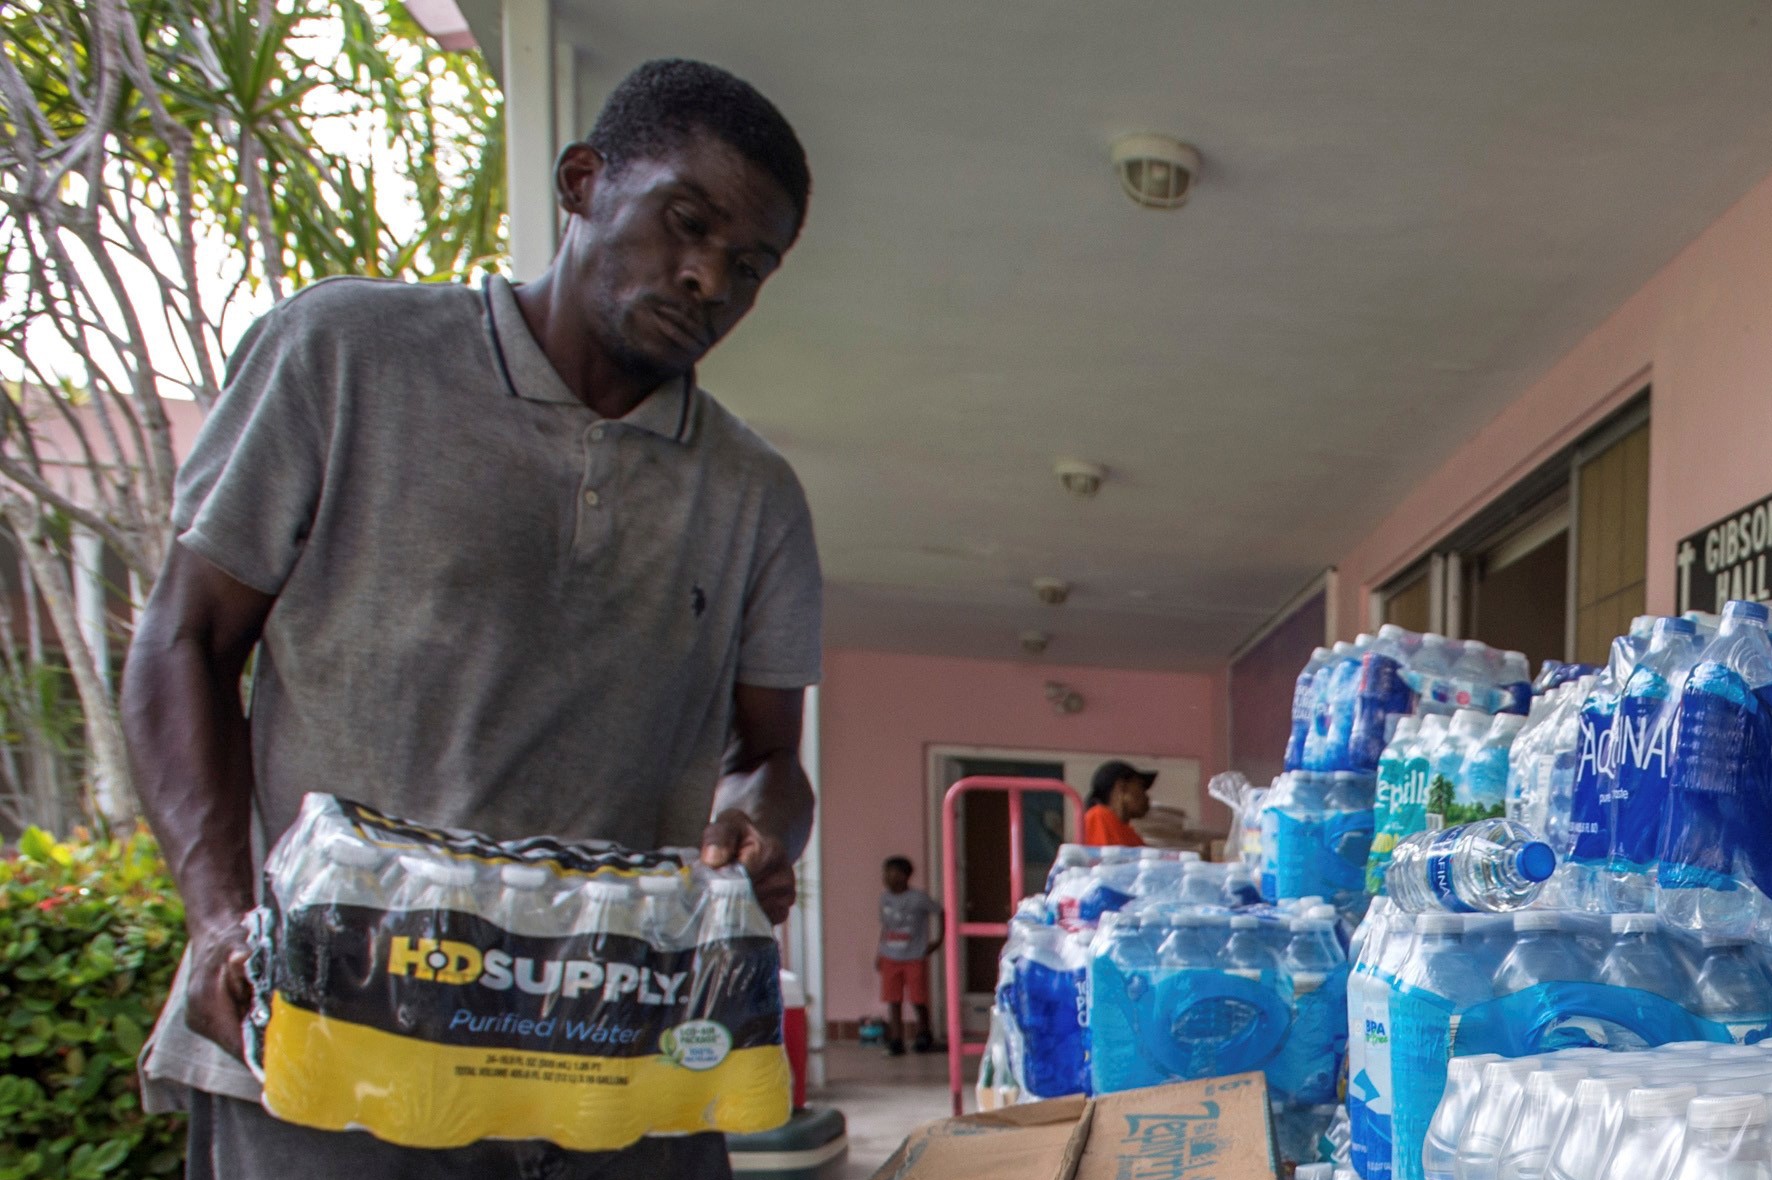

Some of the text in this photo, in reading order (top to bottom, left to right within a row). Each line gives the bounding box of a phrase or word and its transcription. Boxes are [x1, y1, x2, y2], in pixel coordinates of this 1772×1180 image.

[1714, 554, 1771, 616] HALL
[448, 1009, 643, 1046] Purified Water
[1365, 1019, 1386, 1036] BPA
